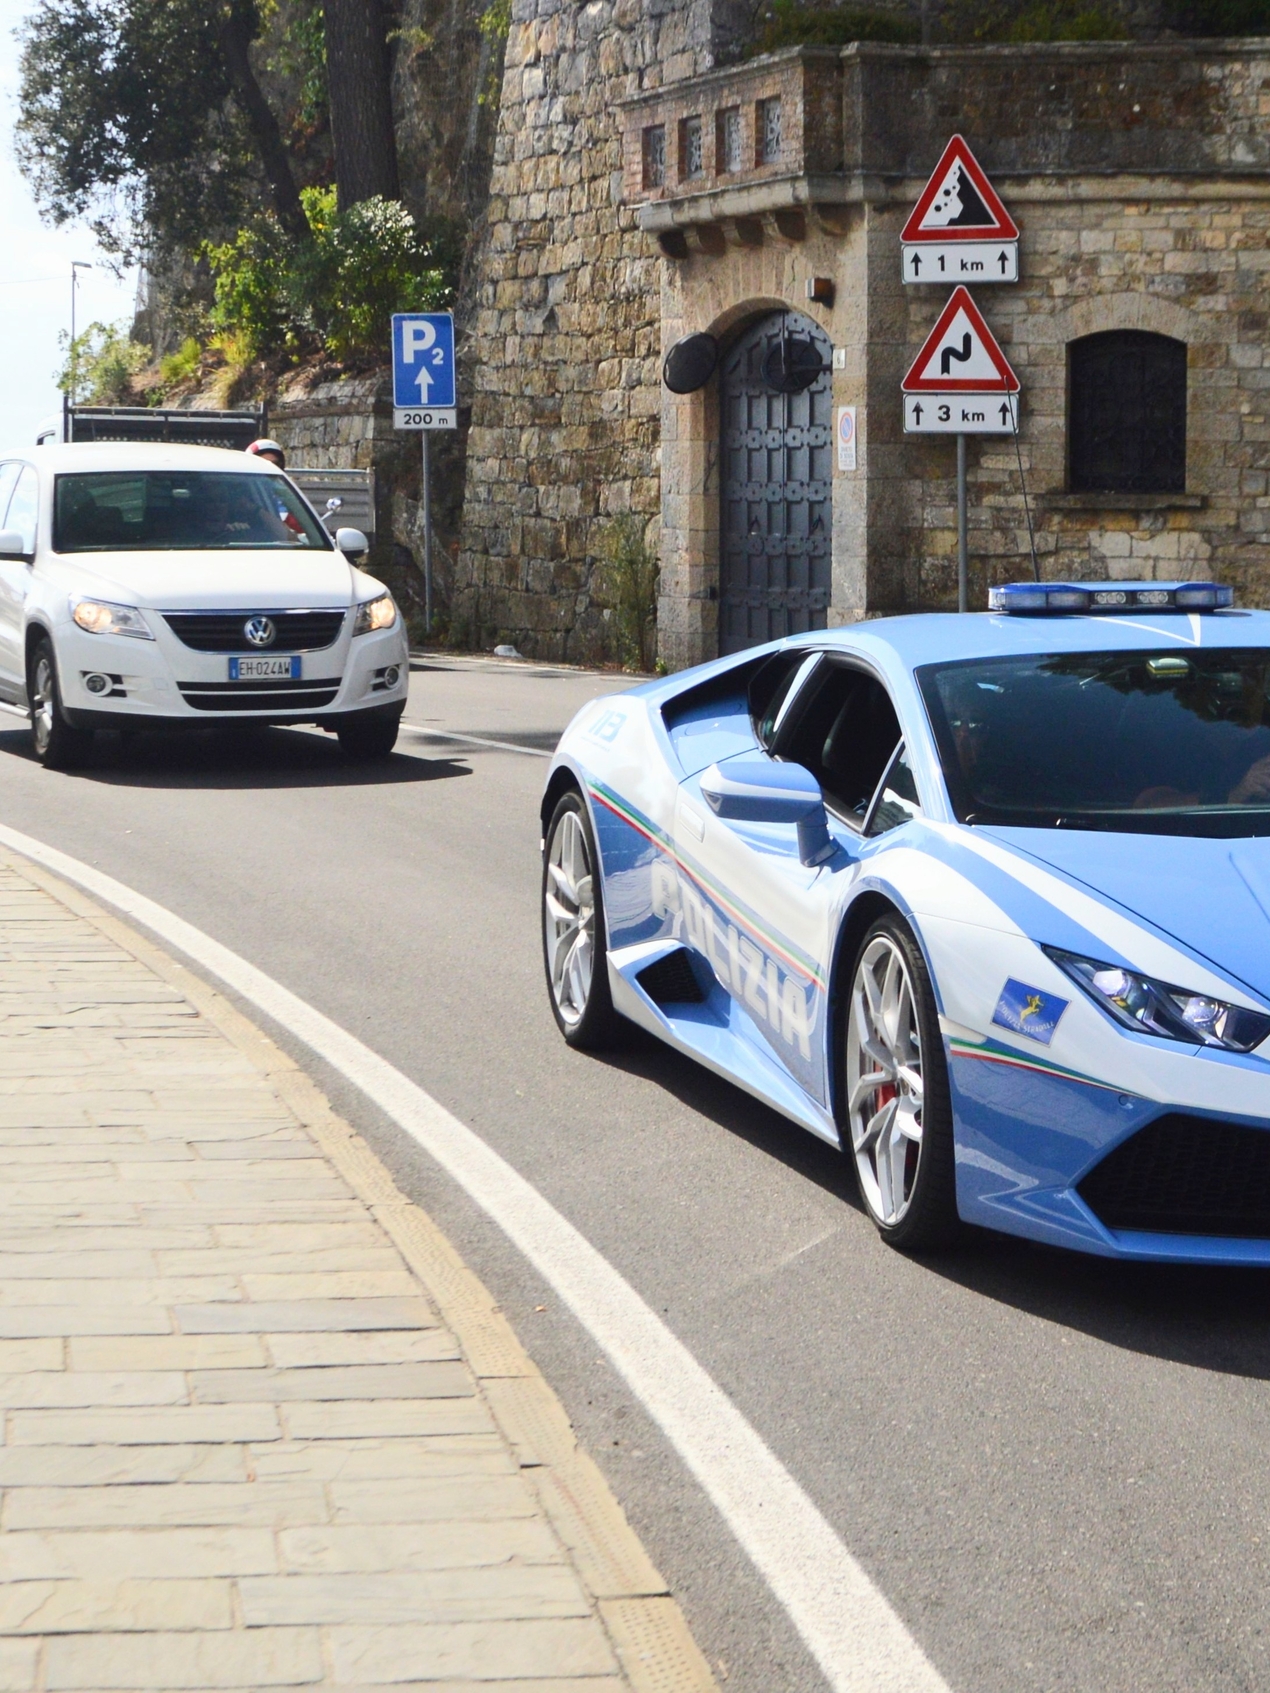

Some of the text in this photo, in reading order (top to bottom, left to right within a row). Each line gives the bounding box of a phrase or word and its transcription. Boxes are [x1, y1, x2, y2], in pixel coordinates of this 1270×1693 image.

[937, 255, 984, 271] 1 km
[403, 413, 448, 425] 200 m
[938, 405, 985, 422] 3 km
[652, 858, 811, 1062] POLIZIA
